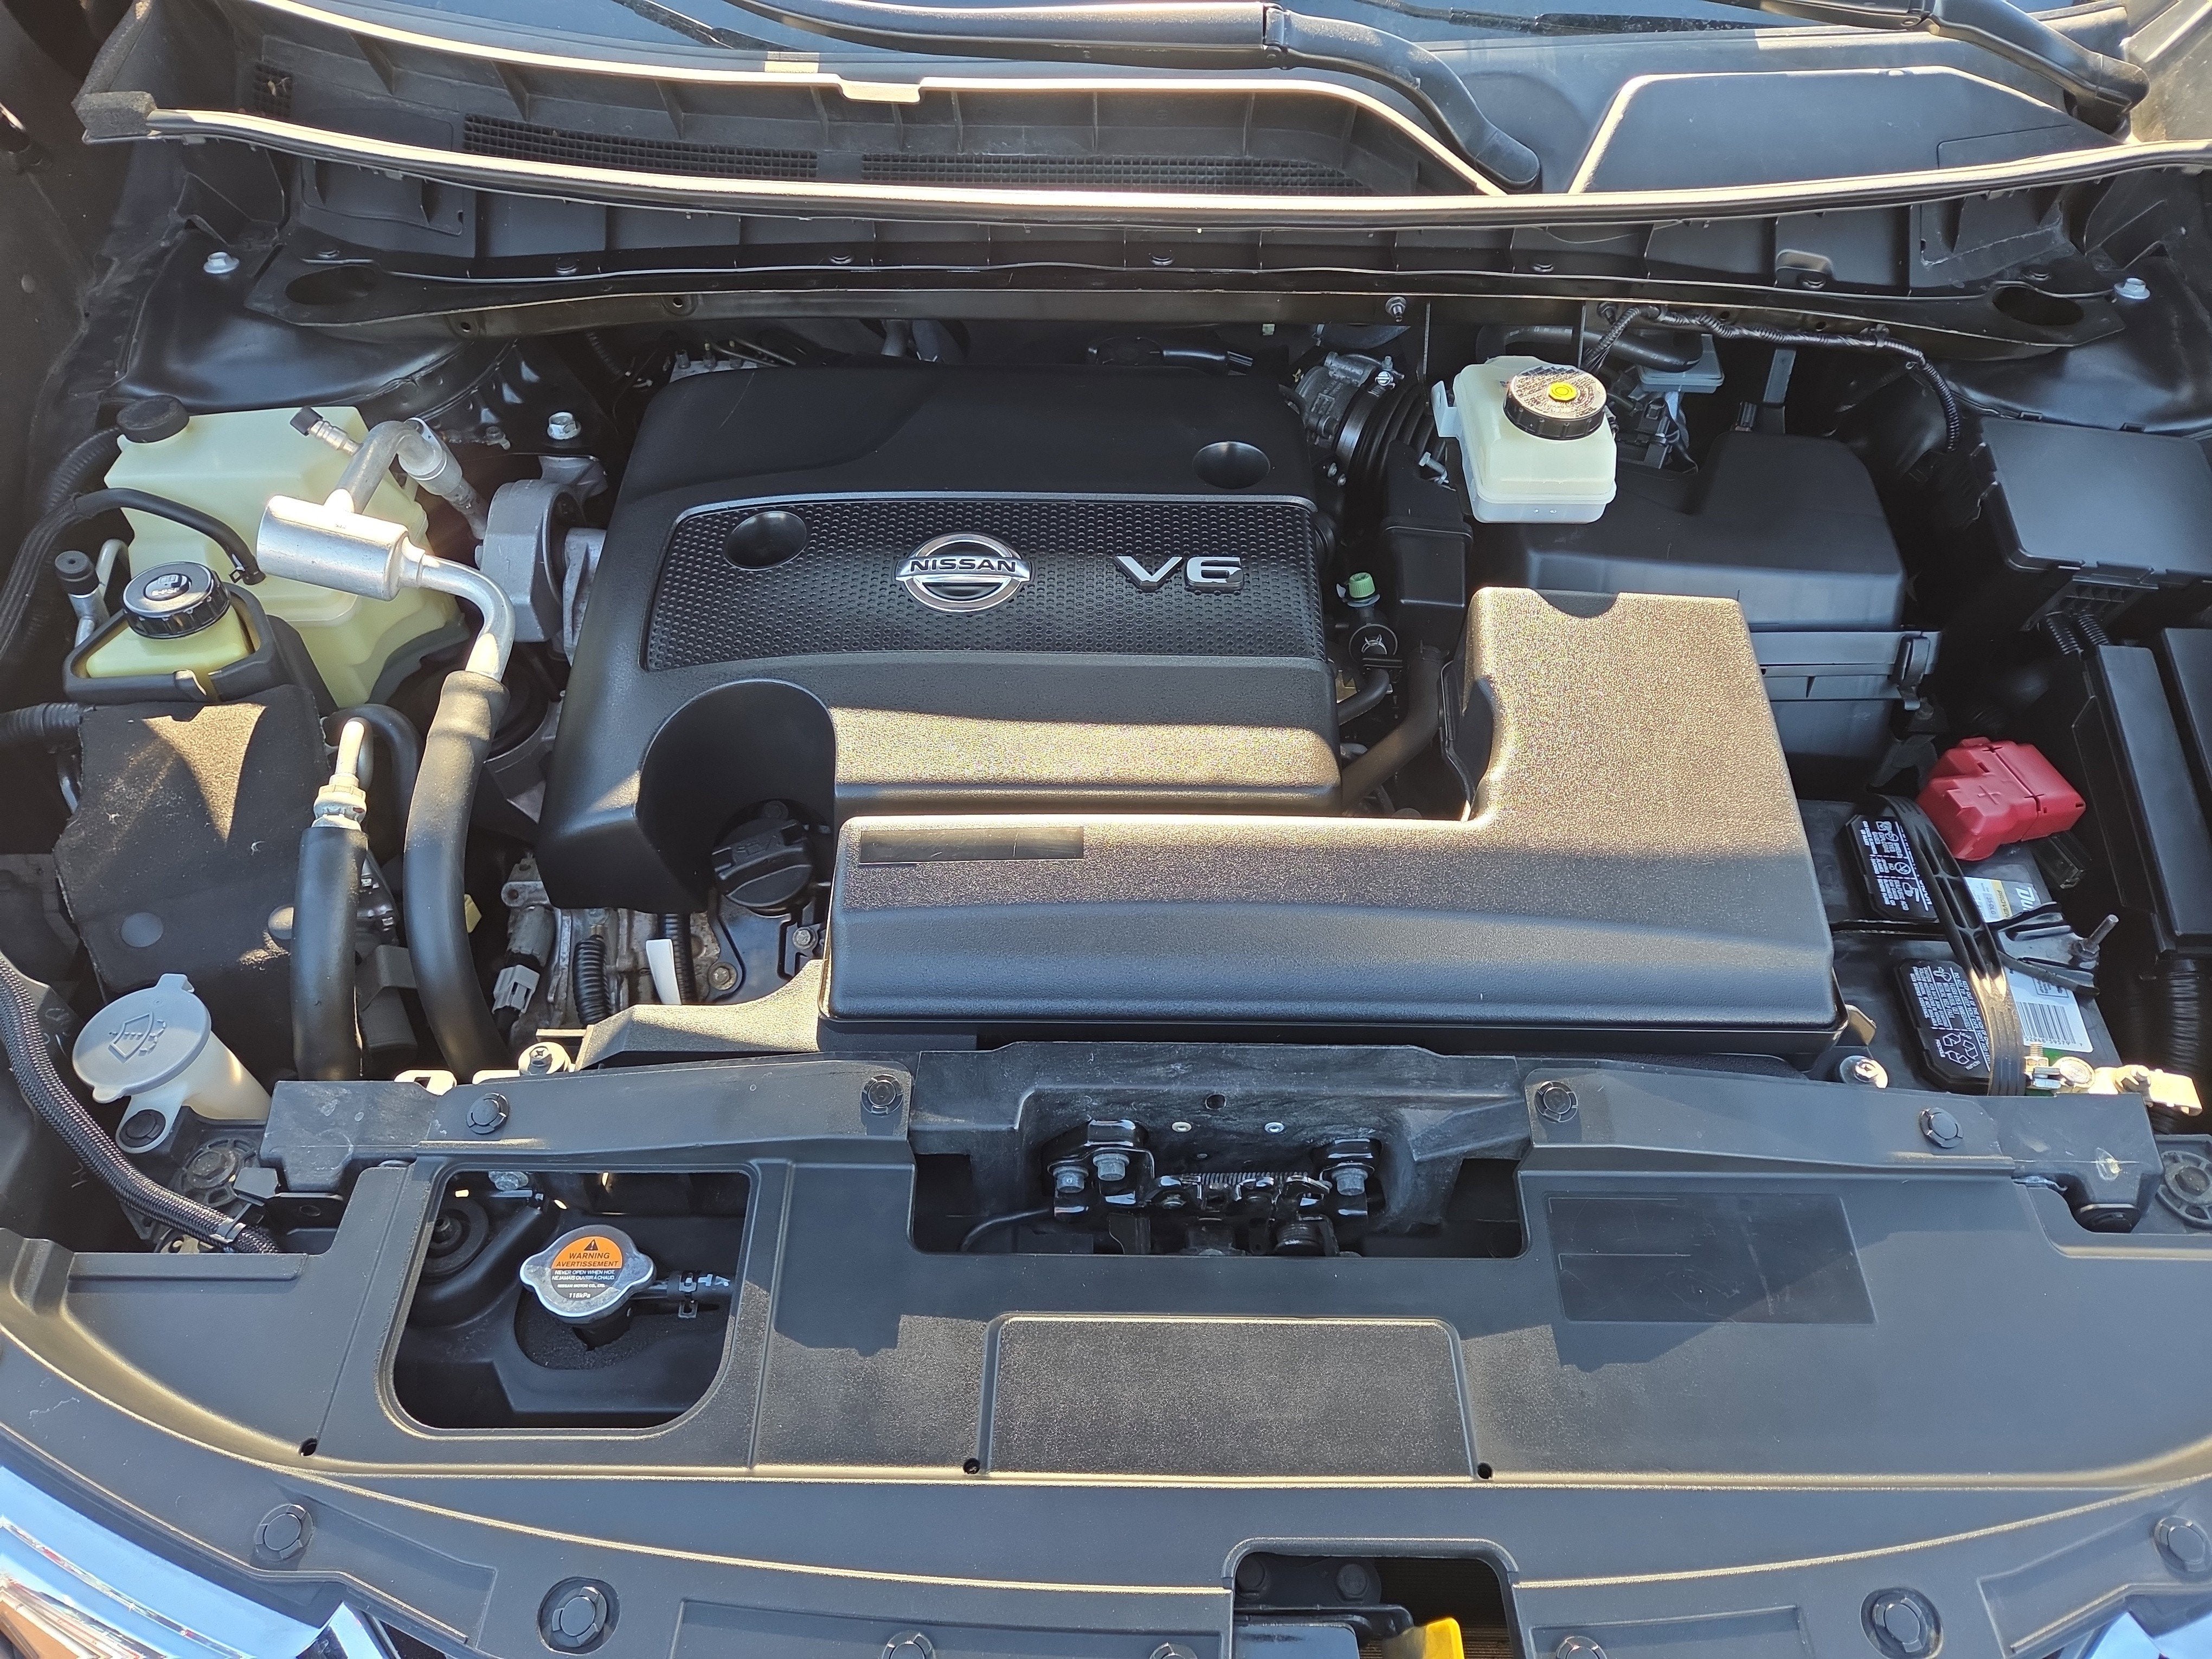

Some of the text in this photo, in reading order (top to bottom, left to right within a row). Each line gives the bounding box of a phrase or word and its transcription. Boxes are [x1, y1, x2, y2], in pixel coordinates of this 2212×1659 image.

[910, 558, 1016, 573] NISSAN
[1113, 555, 1244, 590] V6
[2015, 887, 2035, 911] Du
